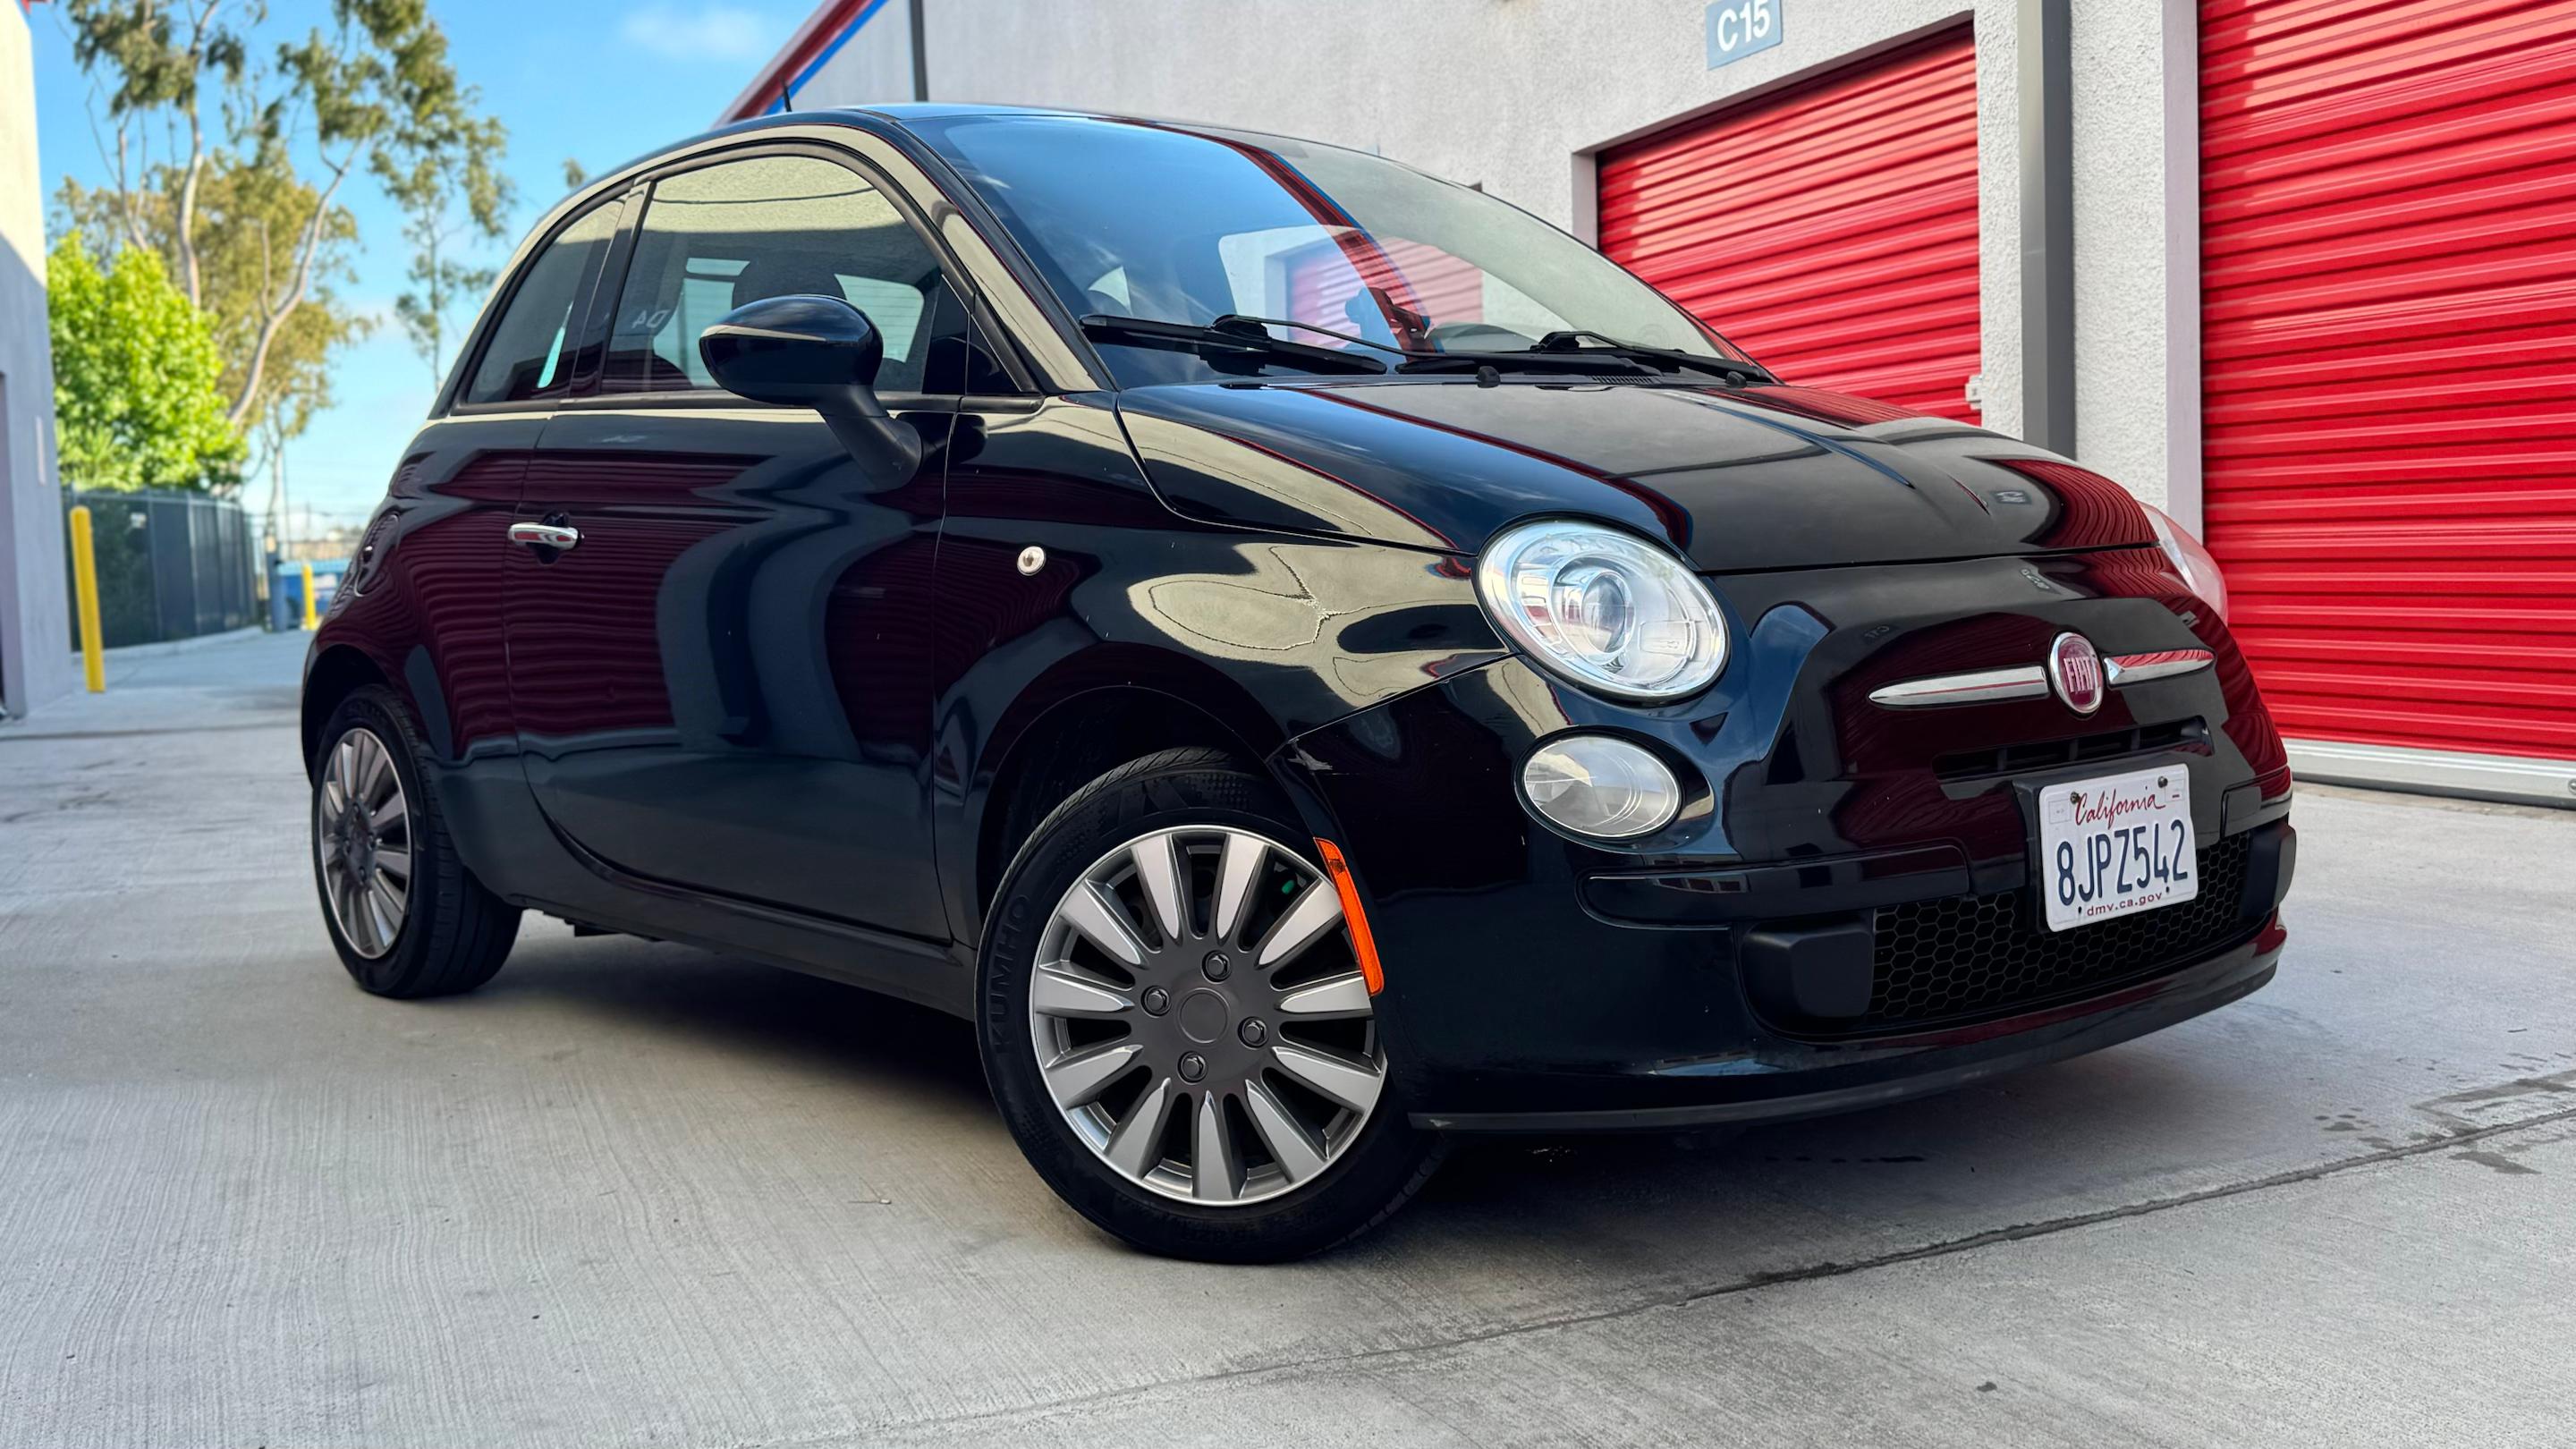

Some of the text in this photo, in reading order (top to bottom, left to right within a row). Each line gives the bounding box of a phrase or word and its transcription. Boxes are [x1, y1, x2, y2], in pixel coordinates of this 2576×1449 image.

[1717, 0, 1770, 51] C15
[2063, 656, 2093, 692] FIAT
[2075, 787, 2165, 830] California
[2056, 819, 2188, 906] 8JPZ542
[2087, 892, 2163, 917] dmv.ca.gov
[990, 894, 1030, 1054] KUMHO
